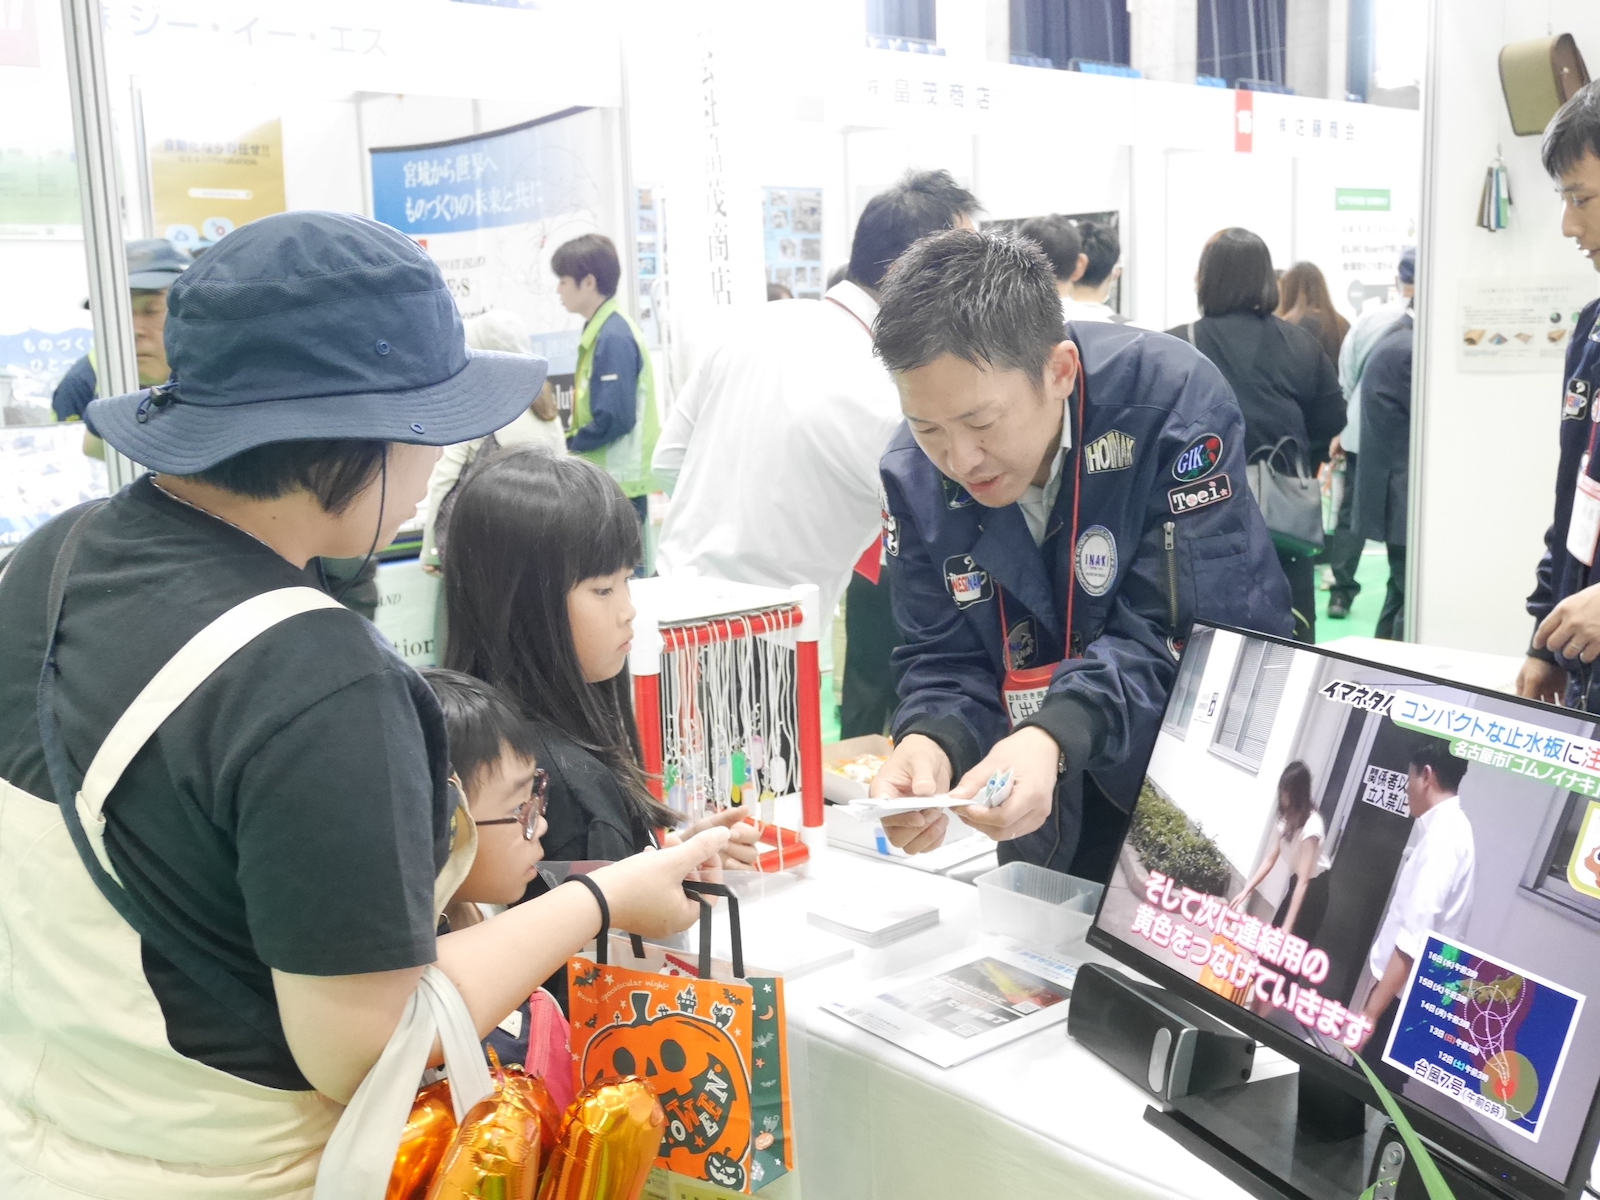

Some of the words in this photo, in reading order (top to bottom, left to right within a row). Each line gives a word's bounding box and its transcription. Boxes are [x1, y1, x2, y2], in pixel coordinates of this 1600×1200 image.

[1177, 444, 1205, 474] GIK
[1366, 787, 1408, 815] 立入禁止
[1146, 870, 1330, 984] そして次に連結用の
[1131, 905, 1372, 1048] 黄色をつなげていきます
